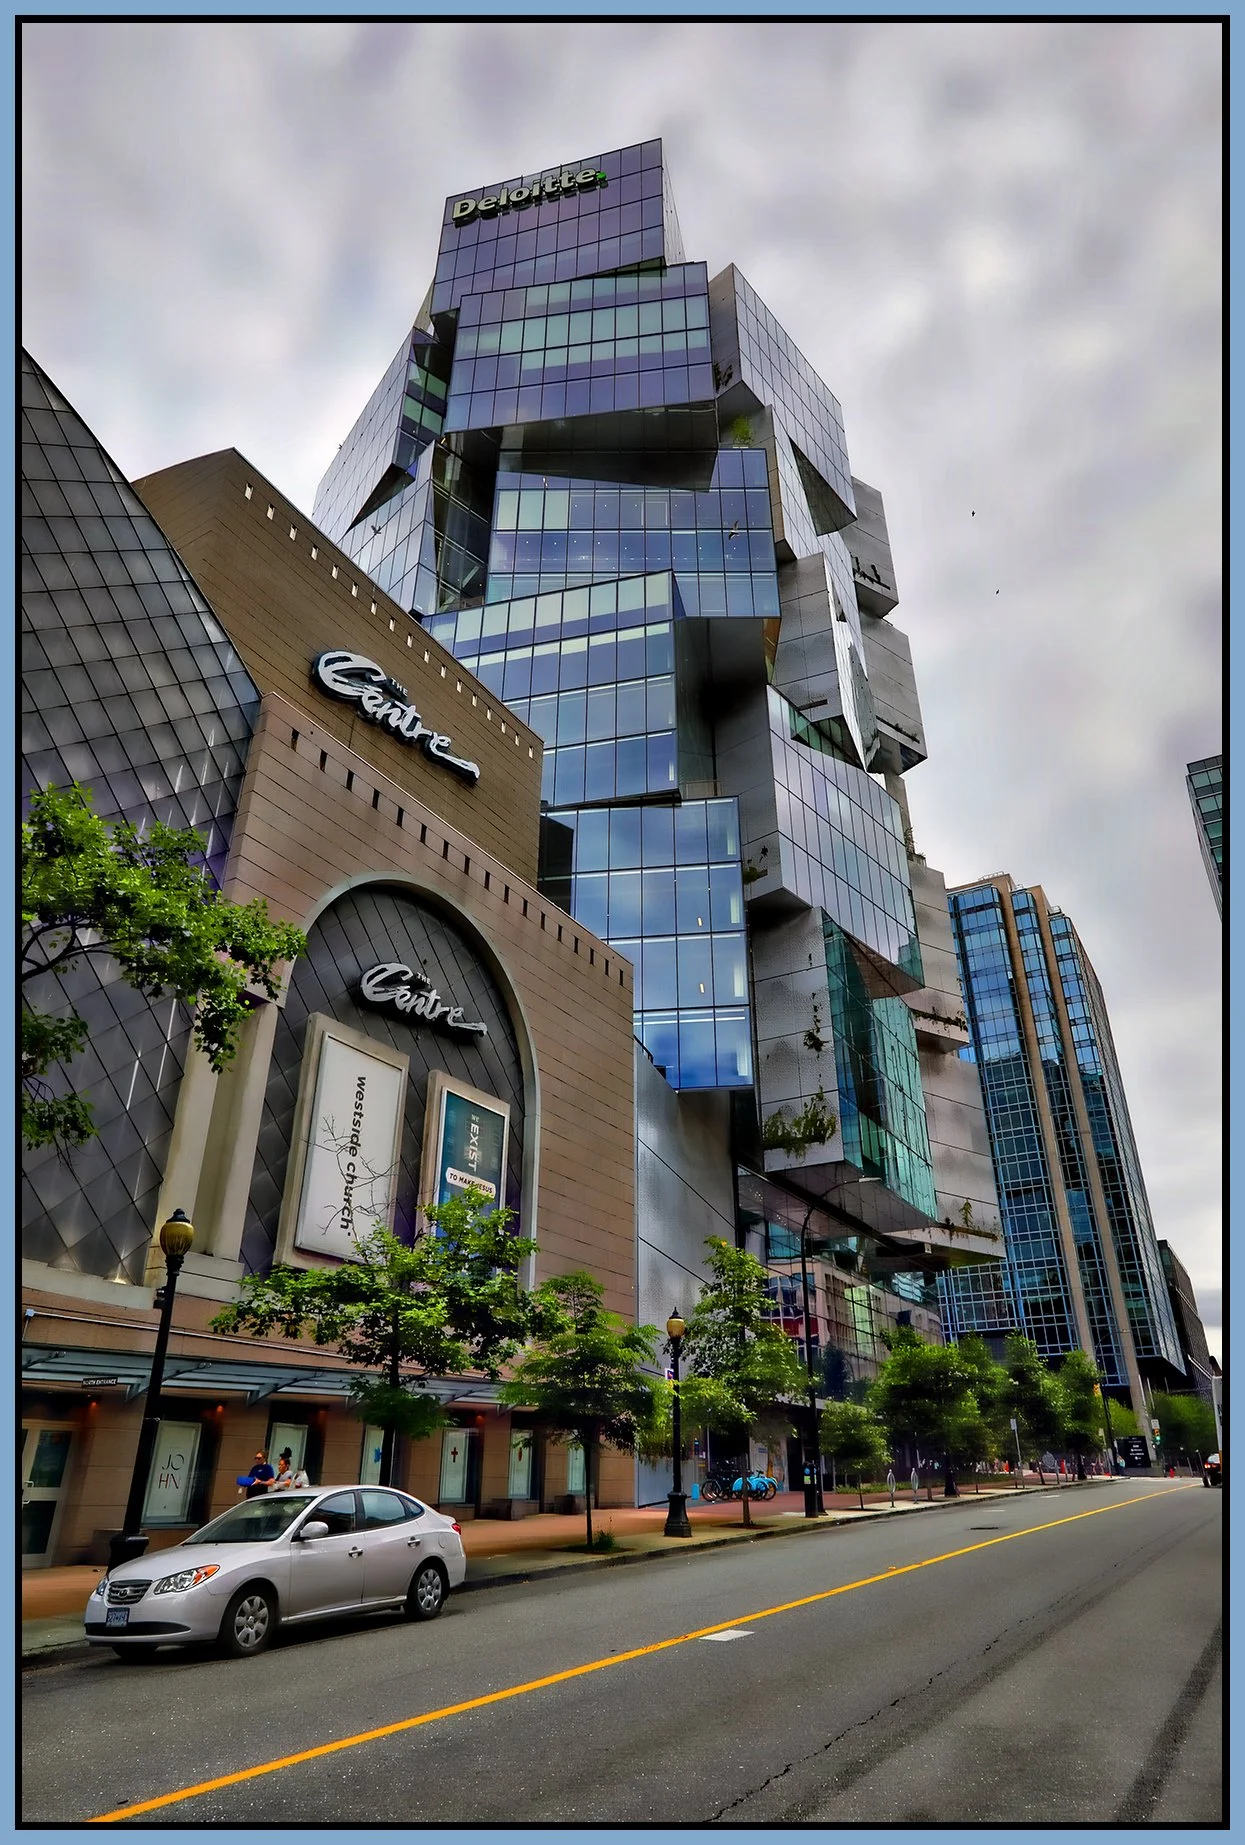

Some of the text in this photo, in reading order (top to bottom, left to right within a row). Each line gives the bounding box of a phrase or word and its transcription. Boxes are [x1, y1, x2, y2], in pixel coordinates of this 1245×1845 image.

[315, 650, 480, 781] Centre
[390, 677, 408, 697] THE
[360, 962, 487, 1035] Centre
[348, 1076, 366, 1158] westside
[468, 1122, 480, 1173] EXIST
[449, 1172, 458, 1181] TO
